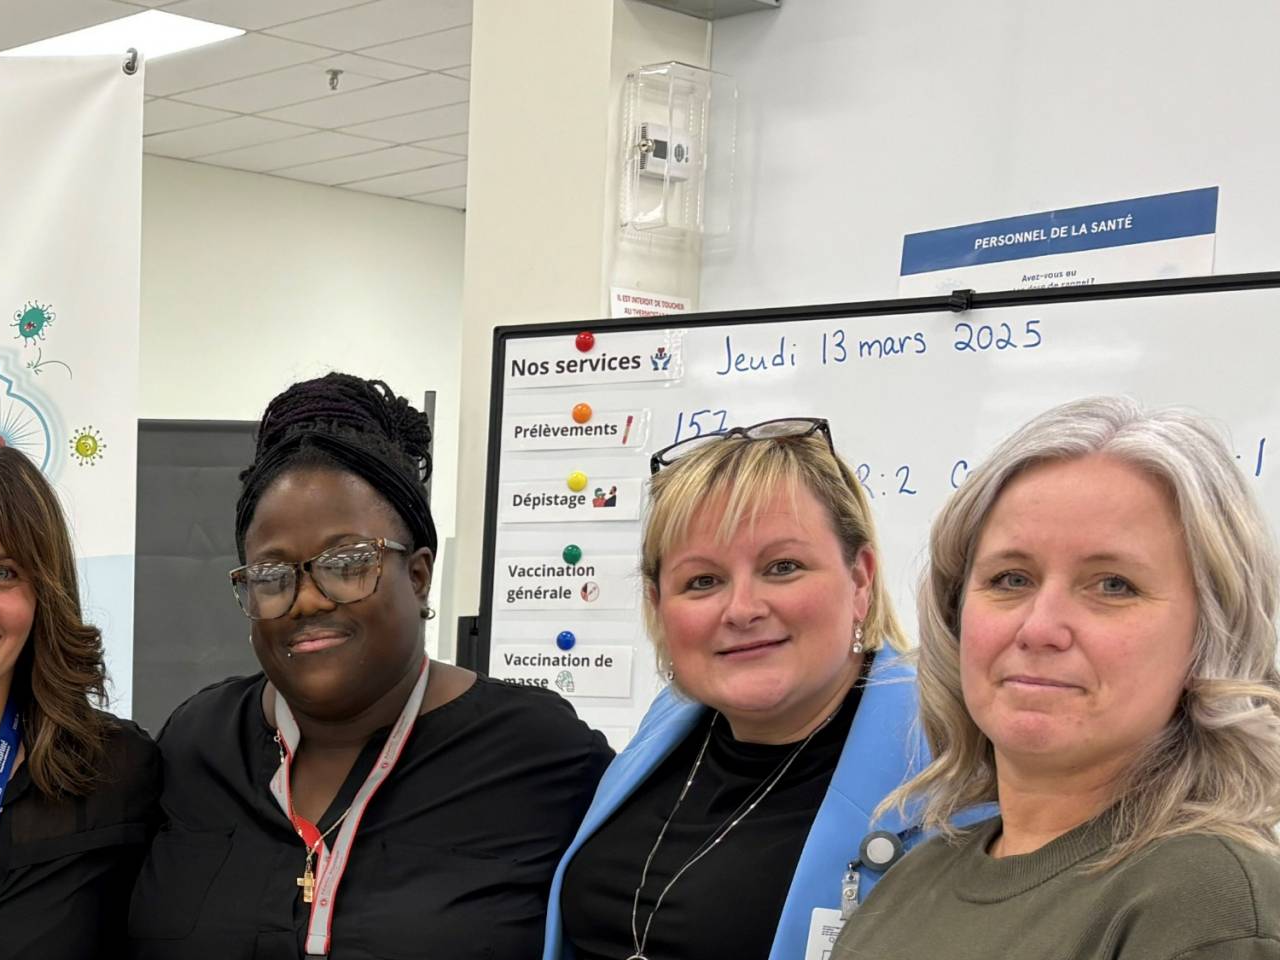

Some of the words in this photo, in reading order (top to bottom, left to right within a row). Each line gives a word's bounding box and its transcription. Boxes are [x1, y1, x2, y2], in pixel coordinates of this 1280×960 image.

[974, 229, 1047, 250] PERSONNEL
[1050, 226, 1068, 239] DE
[1071, 223, 1088, 236] LA
[1091, 214, 1133, 233] SANTÉ
[716, 335, 797, 376] Jeudi
[822, 329, 847, 364] 13
[859, 331, 927, 359] mars
[954, 320, 1042, 352] 2025
[511, 358, 549, 377] Nos
[555, 353, 642, 374] services
[514, 422, 618, 439] Prélèvements
[512, 493, 586, 510] Dépistage
[508, 564, 595, 578] Vaccination
[506, 586, 572, 603] générale
[504, 653, 590, 668] Vaccination
[594, 654, 613, 667] de
